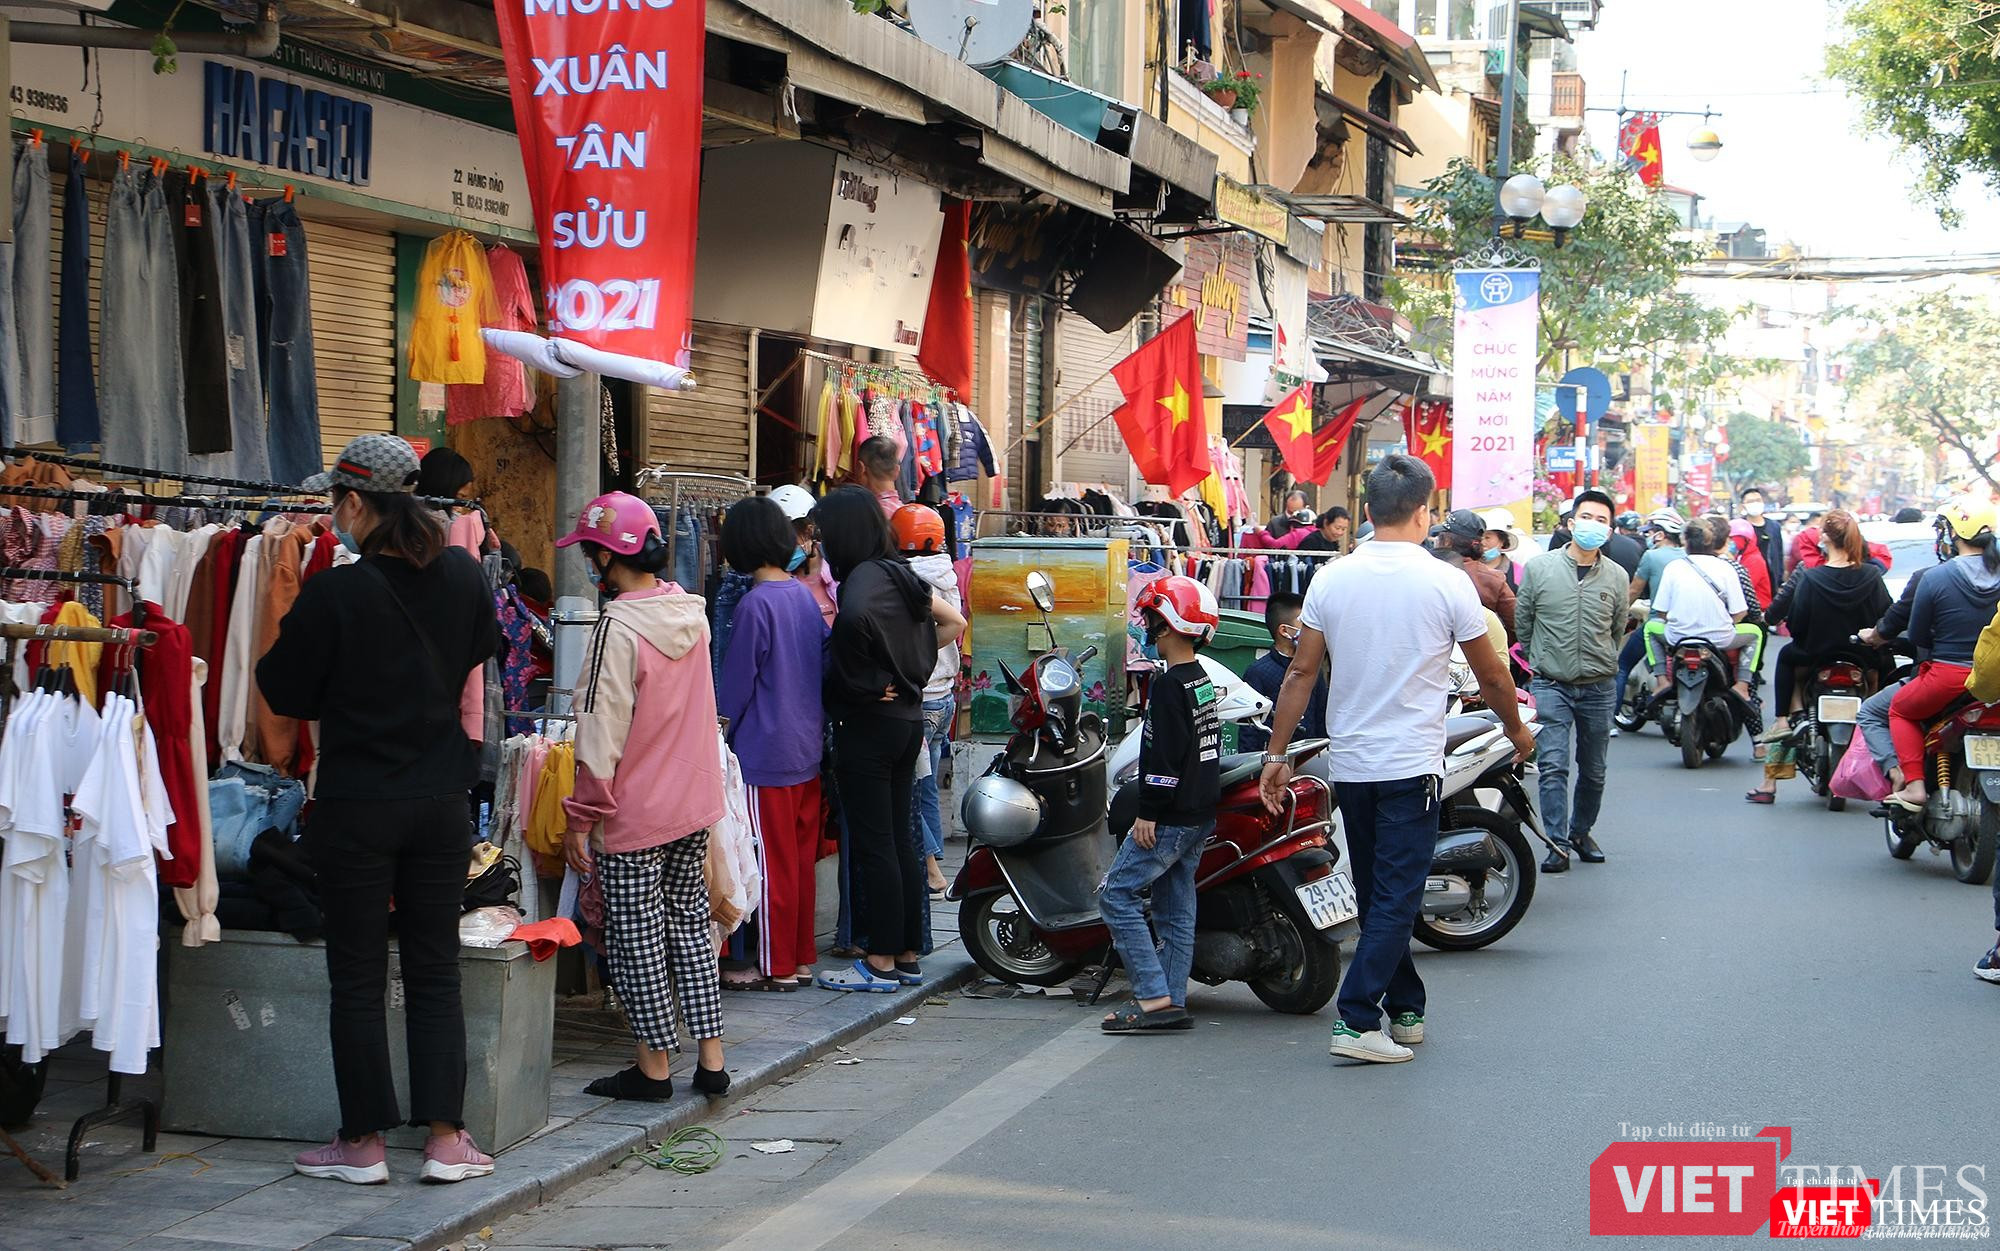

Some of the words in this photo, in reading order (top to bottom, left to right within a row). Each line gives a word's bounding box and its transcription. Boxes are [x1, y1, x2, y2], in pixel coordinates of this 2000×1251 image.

[283, 43, 296, 64] TY
[531, 43, 667, 96] XUÂN
[204, 60, 373, 187] HAFASCO
[555, 122, 646, 170] TÂN
[454, 168, 463, 183] 22
[552, 197, 647, 249] SỬU
[1470, 436, 1515, 452] 2021
[1304, 876, 1347, 906] 29-C1
